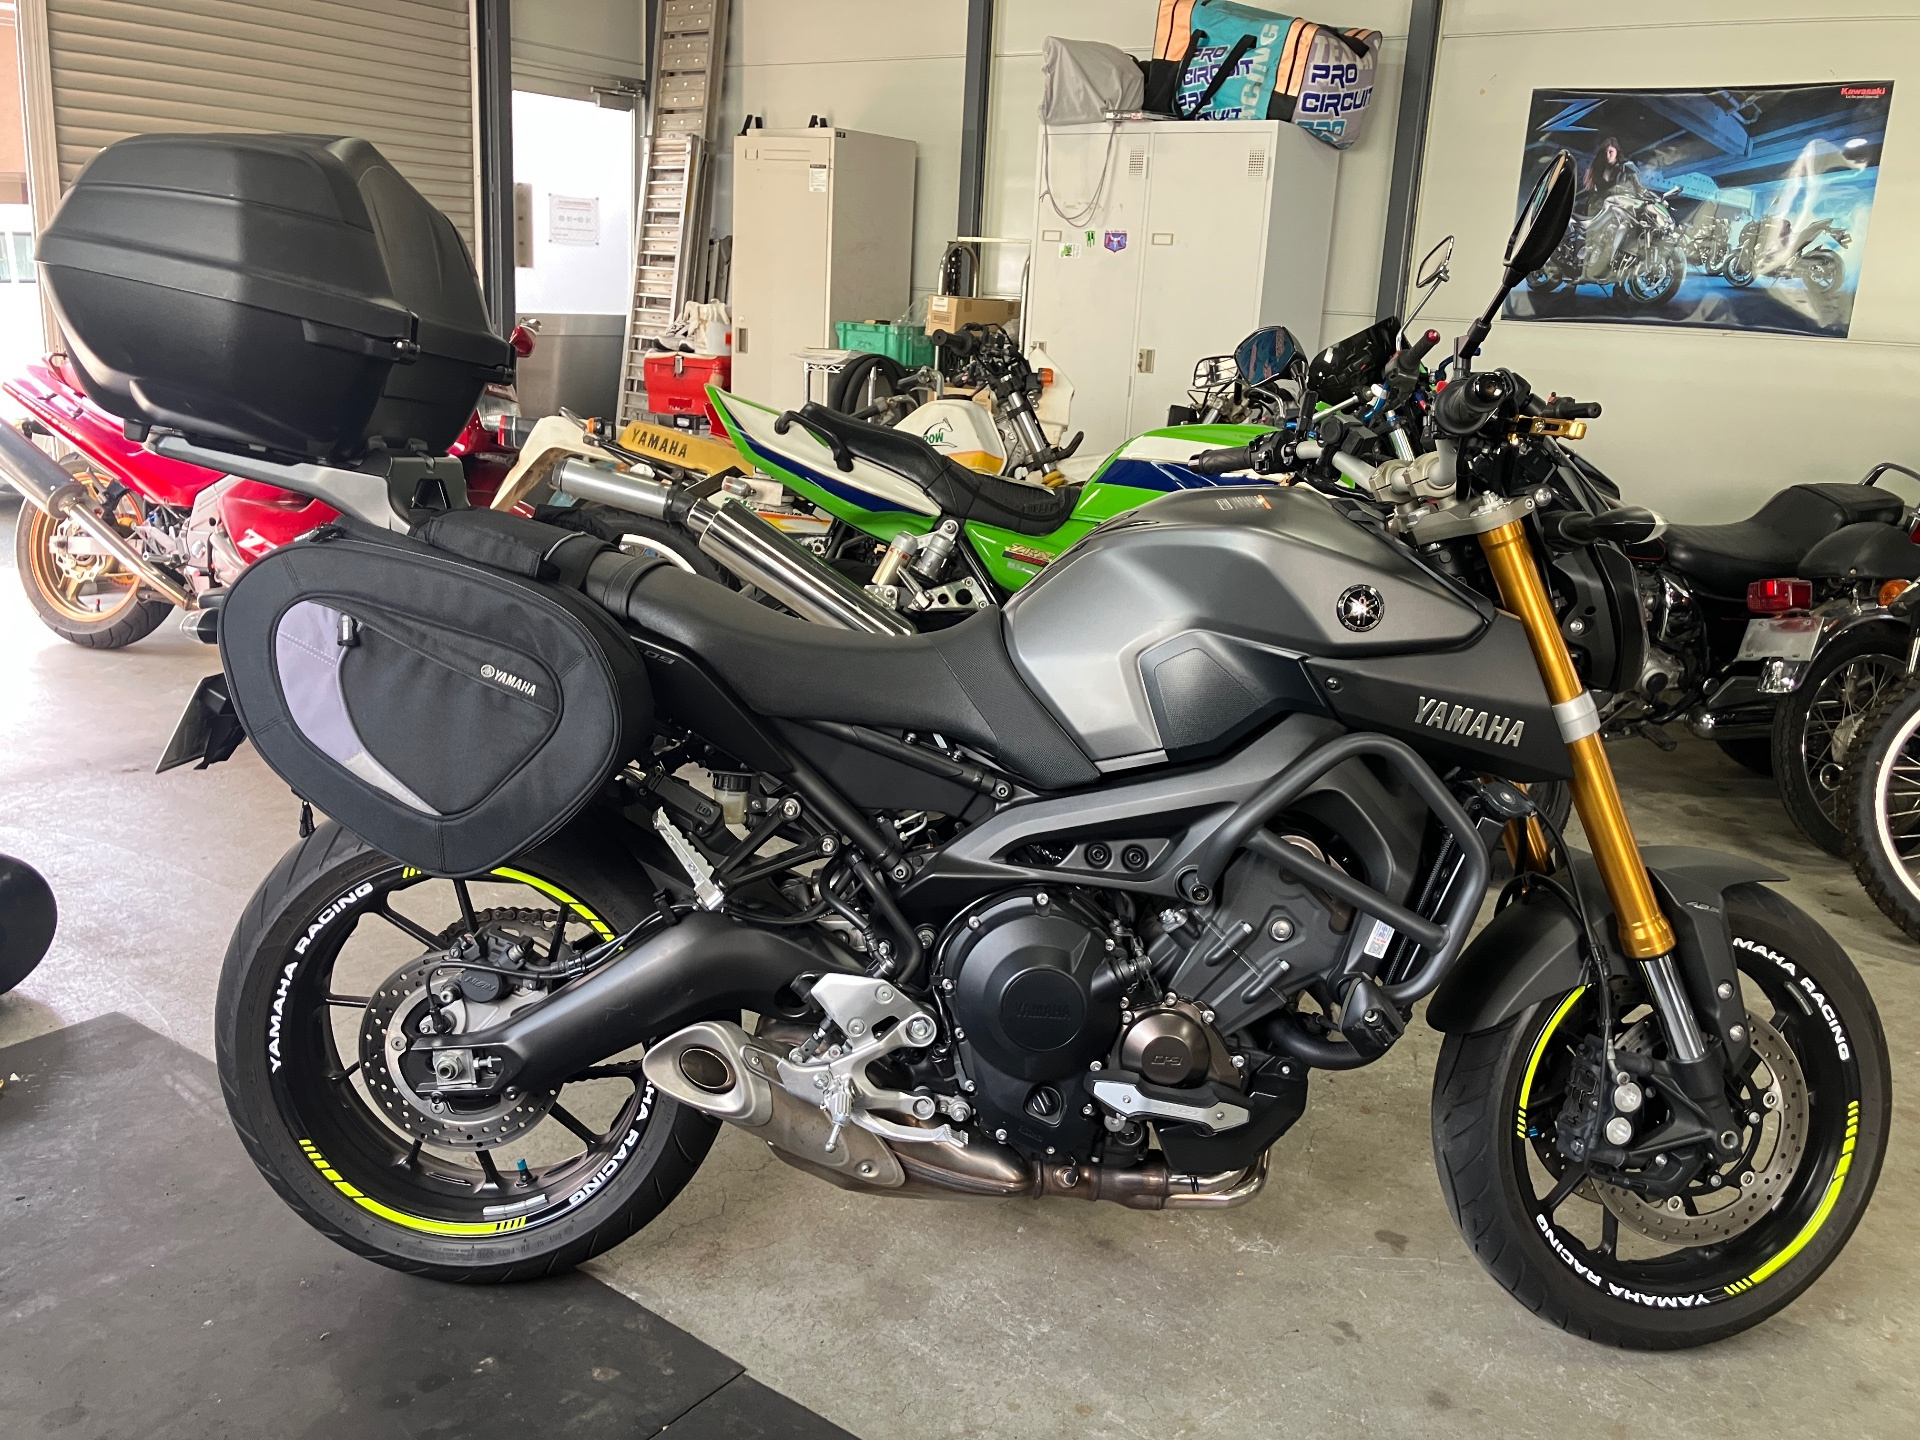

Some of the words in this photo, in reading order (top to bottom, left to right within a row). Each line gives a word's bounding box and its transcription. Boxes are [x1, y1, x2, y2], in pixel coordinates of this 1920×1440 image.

[1309, 63, 1358, 89] PRO
[1841, 87, 1886, 96] Kawasaki
[1300, 86, 1374, 117] CIRCUIT
[631, 428, 689, 459] YAMAHA
[494, 669, 537, 697] YAMAHA
[1414, 695, 1525, 748] YAMAHA
[269, 961, 299, 1074] YAMAHA
[294, 882, 374, 954] RACING
[1732, 937, 1796, 977] MAHA
[1800, 976, 1850, 1061] RACING
[568, 1128, 640, 1206] RACING
[1535, 1213, 1603, 1287] RACING
[1608, 1282, 1711, 1309] YAMAHA
